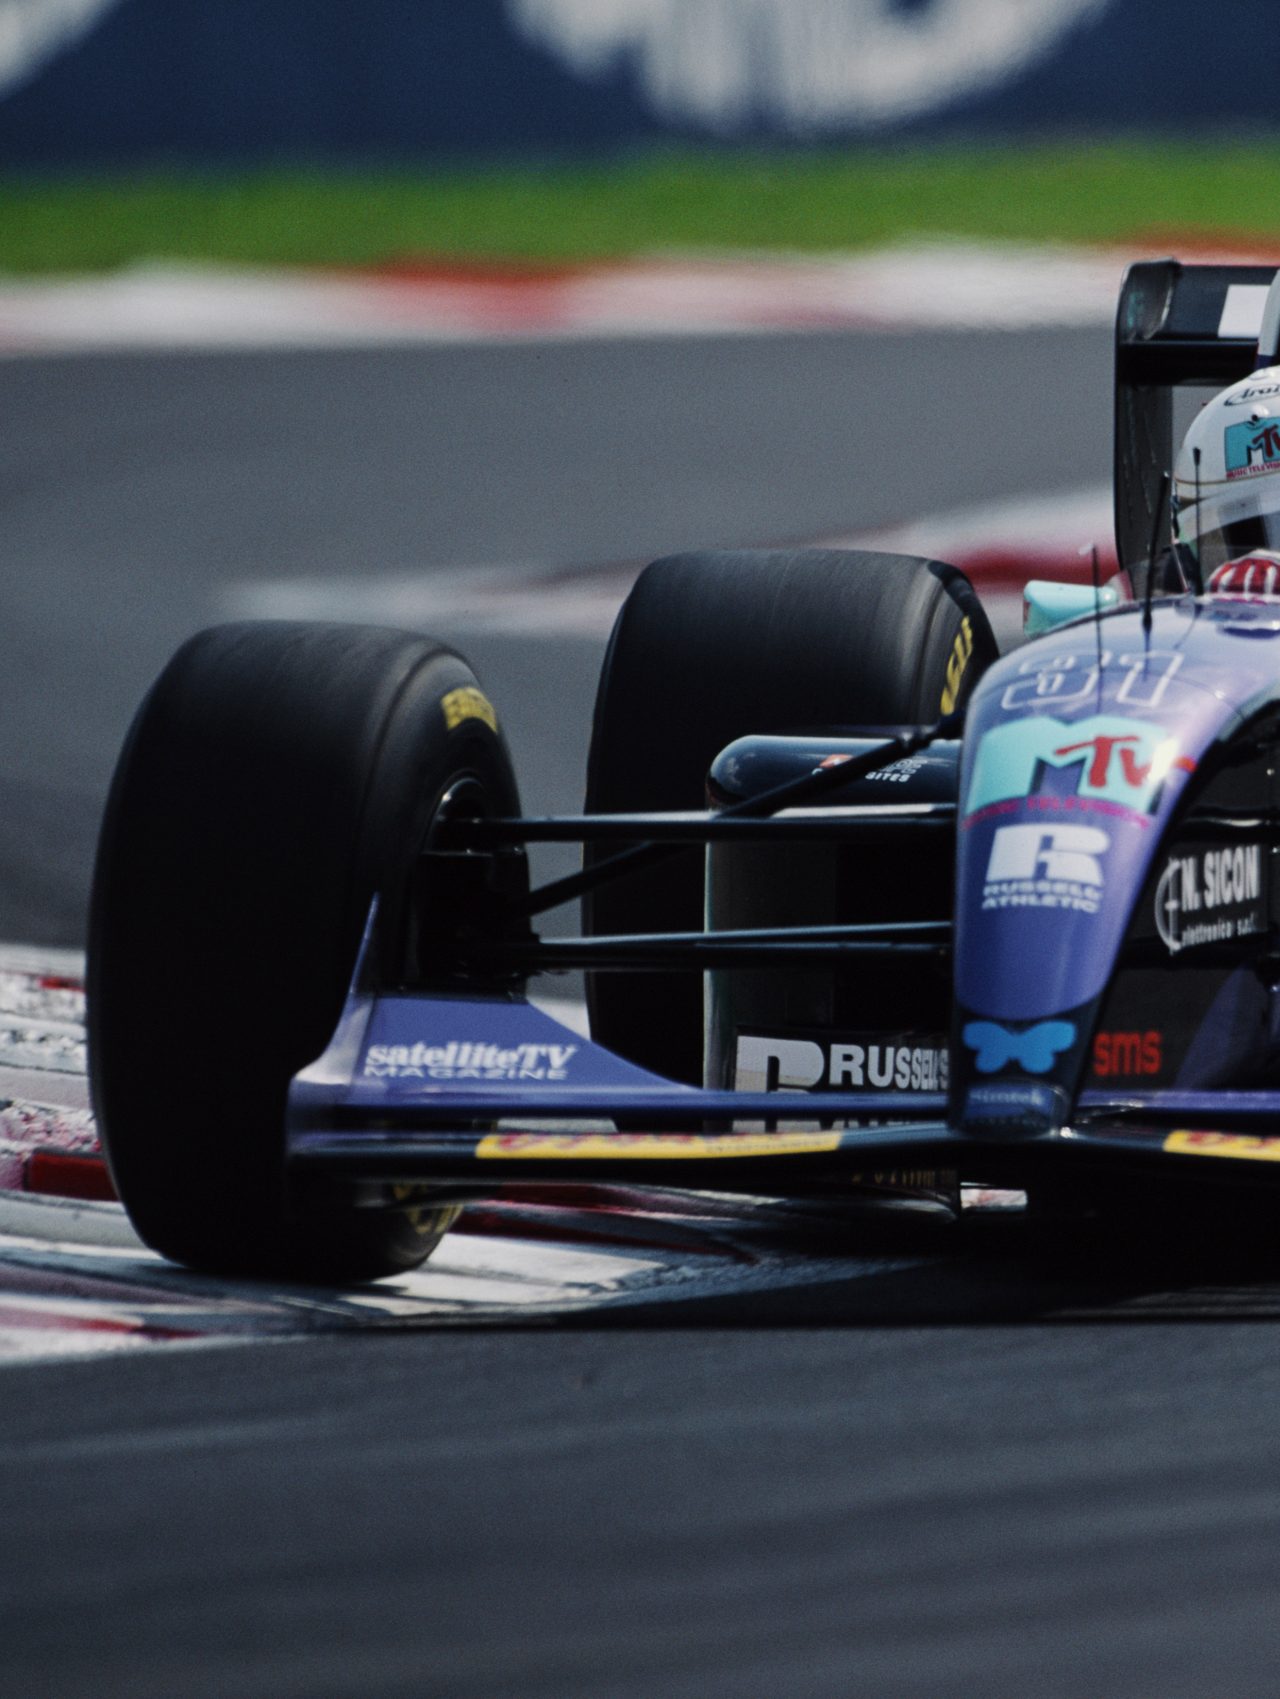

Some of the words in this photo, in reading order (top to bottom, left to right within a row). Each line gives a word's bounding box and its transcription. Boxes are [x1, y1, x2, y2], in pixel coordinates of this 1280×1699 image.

[1238, 384, 1280, 400] Arai
[965, 715, 1197, 814] MTV
[1204, 845, 1260, 908] SICON
[983, 880, 1104, 901] RUSSELL
[982, 894, 1100, 914] ATHLETIC
[1093, 1030, 1162, 1076] sms
[365, 1066, 567, 1080] MAGAZINE
